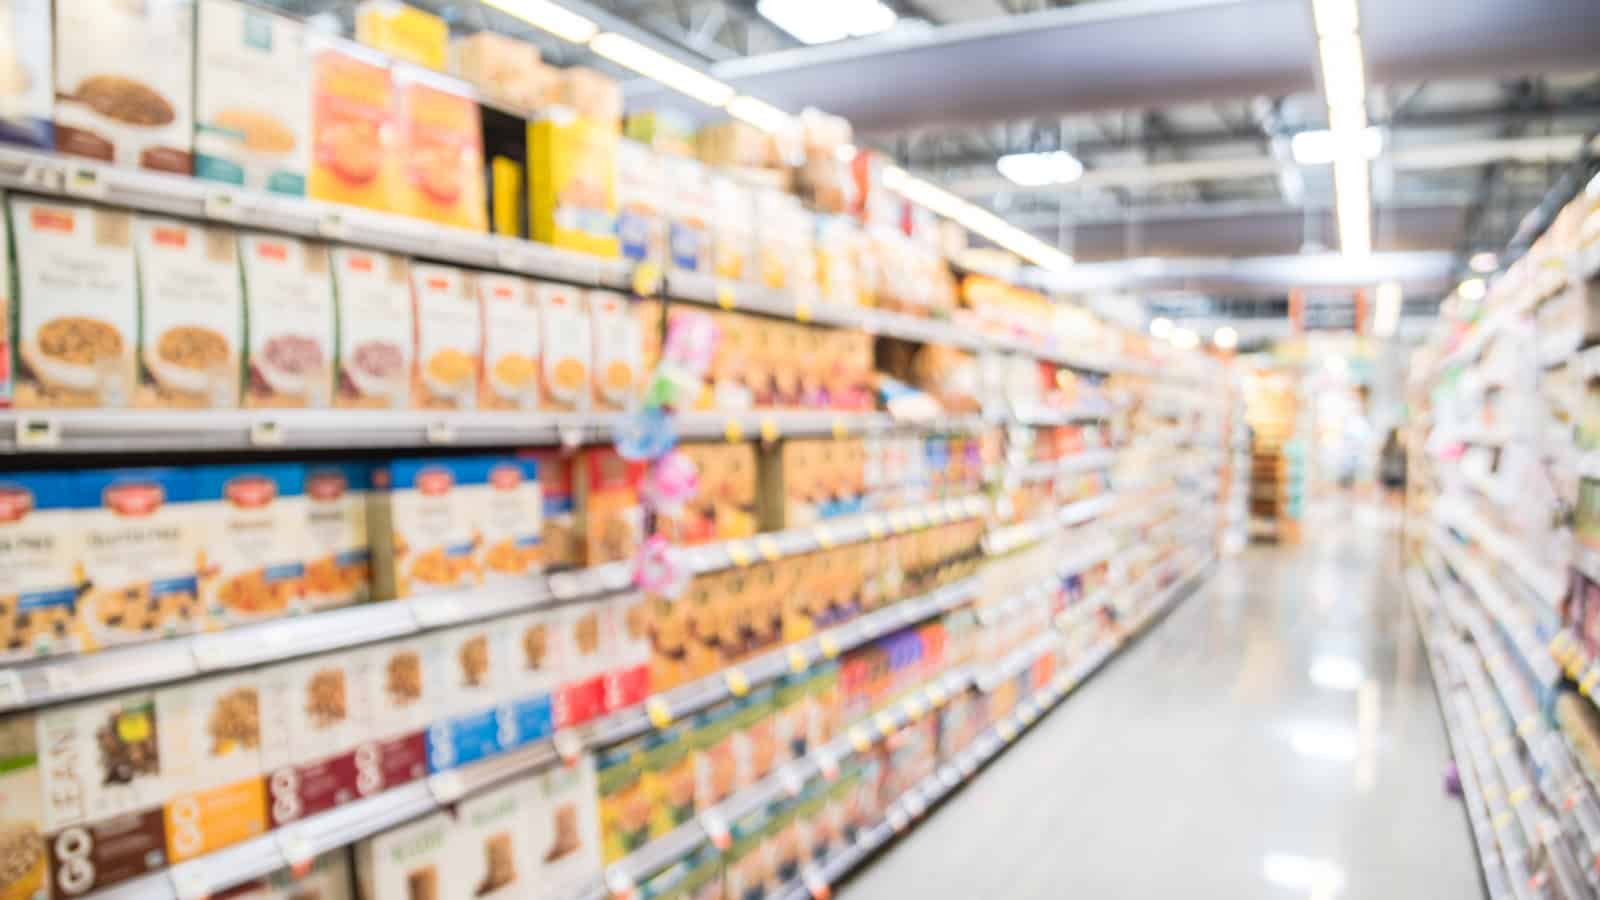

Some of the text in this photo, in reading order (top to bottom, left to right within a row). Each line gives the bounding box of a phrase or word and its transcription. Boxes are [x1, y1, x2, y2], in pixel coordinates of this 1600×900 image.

[49, 726, 86, 824] LEAN
[271, 768, 299, 824] GO
[355, 743, 382, 797] GO
[171, 796, 204, 855] GO
[55, 826, 94, 895] GO
